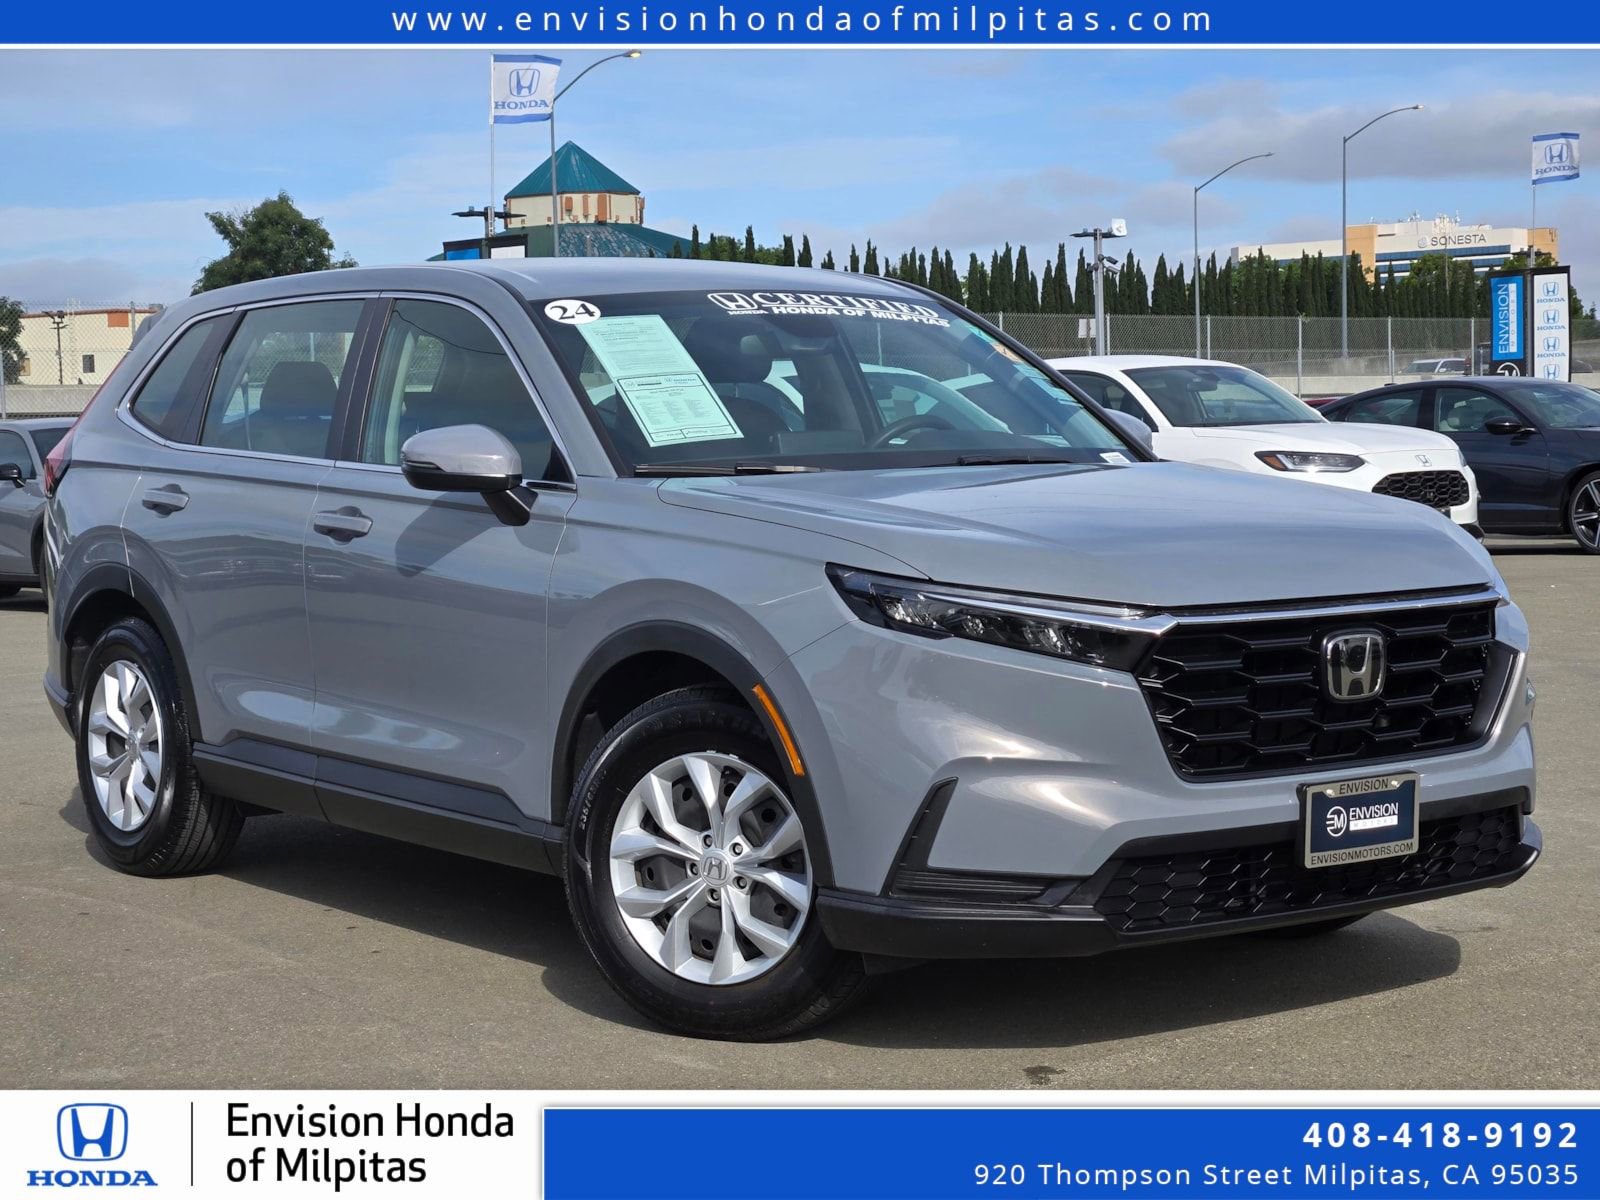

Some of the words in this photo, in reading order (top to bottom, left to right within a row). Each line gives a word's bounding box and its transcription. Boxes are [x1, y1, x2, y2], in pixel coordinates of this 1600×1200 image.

[494, 100, 549, 110] HONDA
[1535, 165, 1579, 175] HONDA
[1431, 234, 1487, 246] SONESTA
[550, 303, 596, 320] 24
[752, 292, 939, 318] CERTIFIED
[772, 306, 840, 316] HONDA
[843, 308, 866, 317] OF
[870, 310, 950, 328] MILPITAS
[1498, 283, 1509, 354] ENVISION
[1339, 778, 1389, 795] ENVISION
[1349, 802, 1399, 820] ENVISION
[1311, 841, 1414, 865] ENVISIONMOTORS.COM
